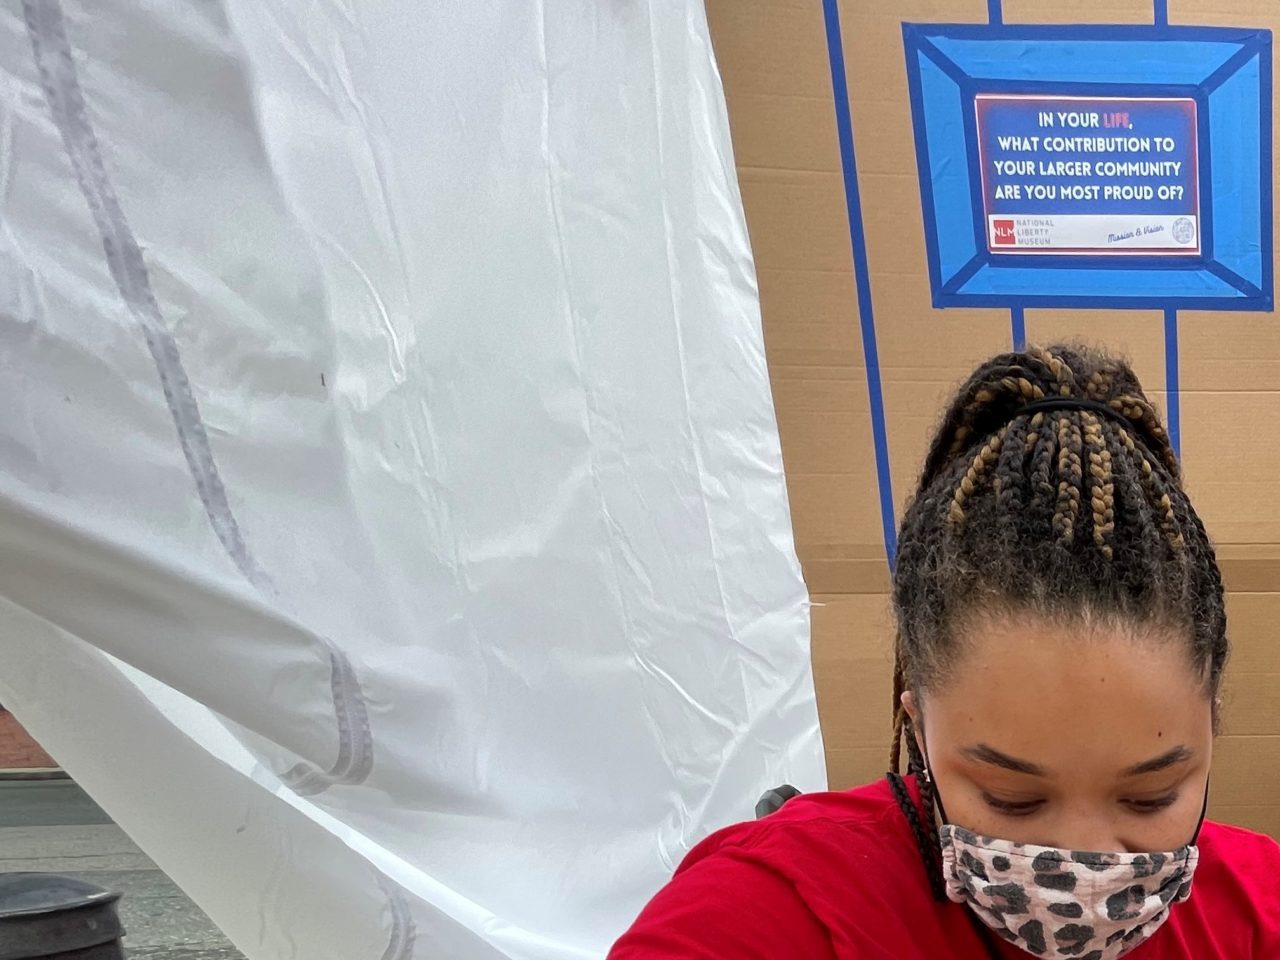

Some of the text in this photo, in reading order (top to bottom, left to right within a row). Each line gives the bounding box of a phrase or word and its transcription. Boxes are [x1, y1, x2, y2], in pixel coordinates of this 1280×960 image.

[1038, 112, 1053, 127] IN
[1057, 112, 1099, 127] YOUR
[998, 136, 1175, 152] WHAT CONTRIBUTION TO
[994, 161, 1181, 176] YOUR LARGER COMMUNITY
[995, 185, 1184, 200] ARE YOU MOST PROUD OF?
[1019, 237, 1051, 245] MUSEUM
